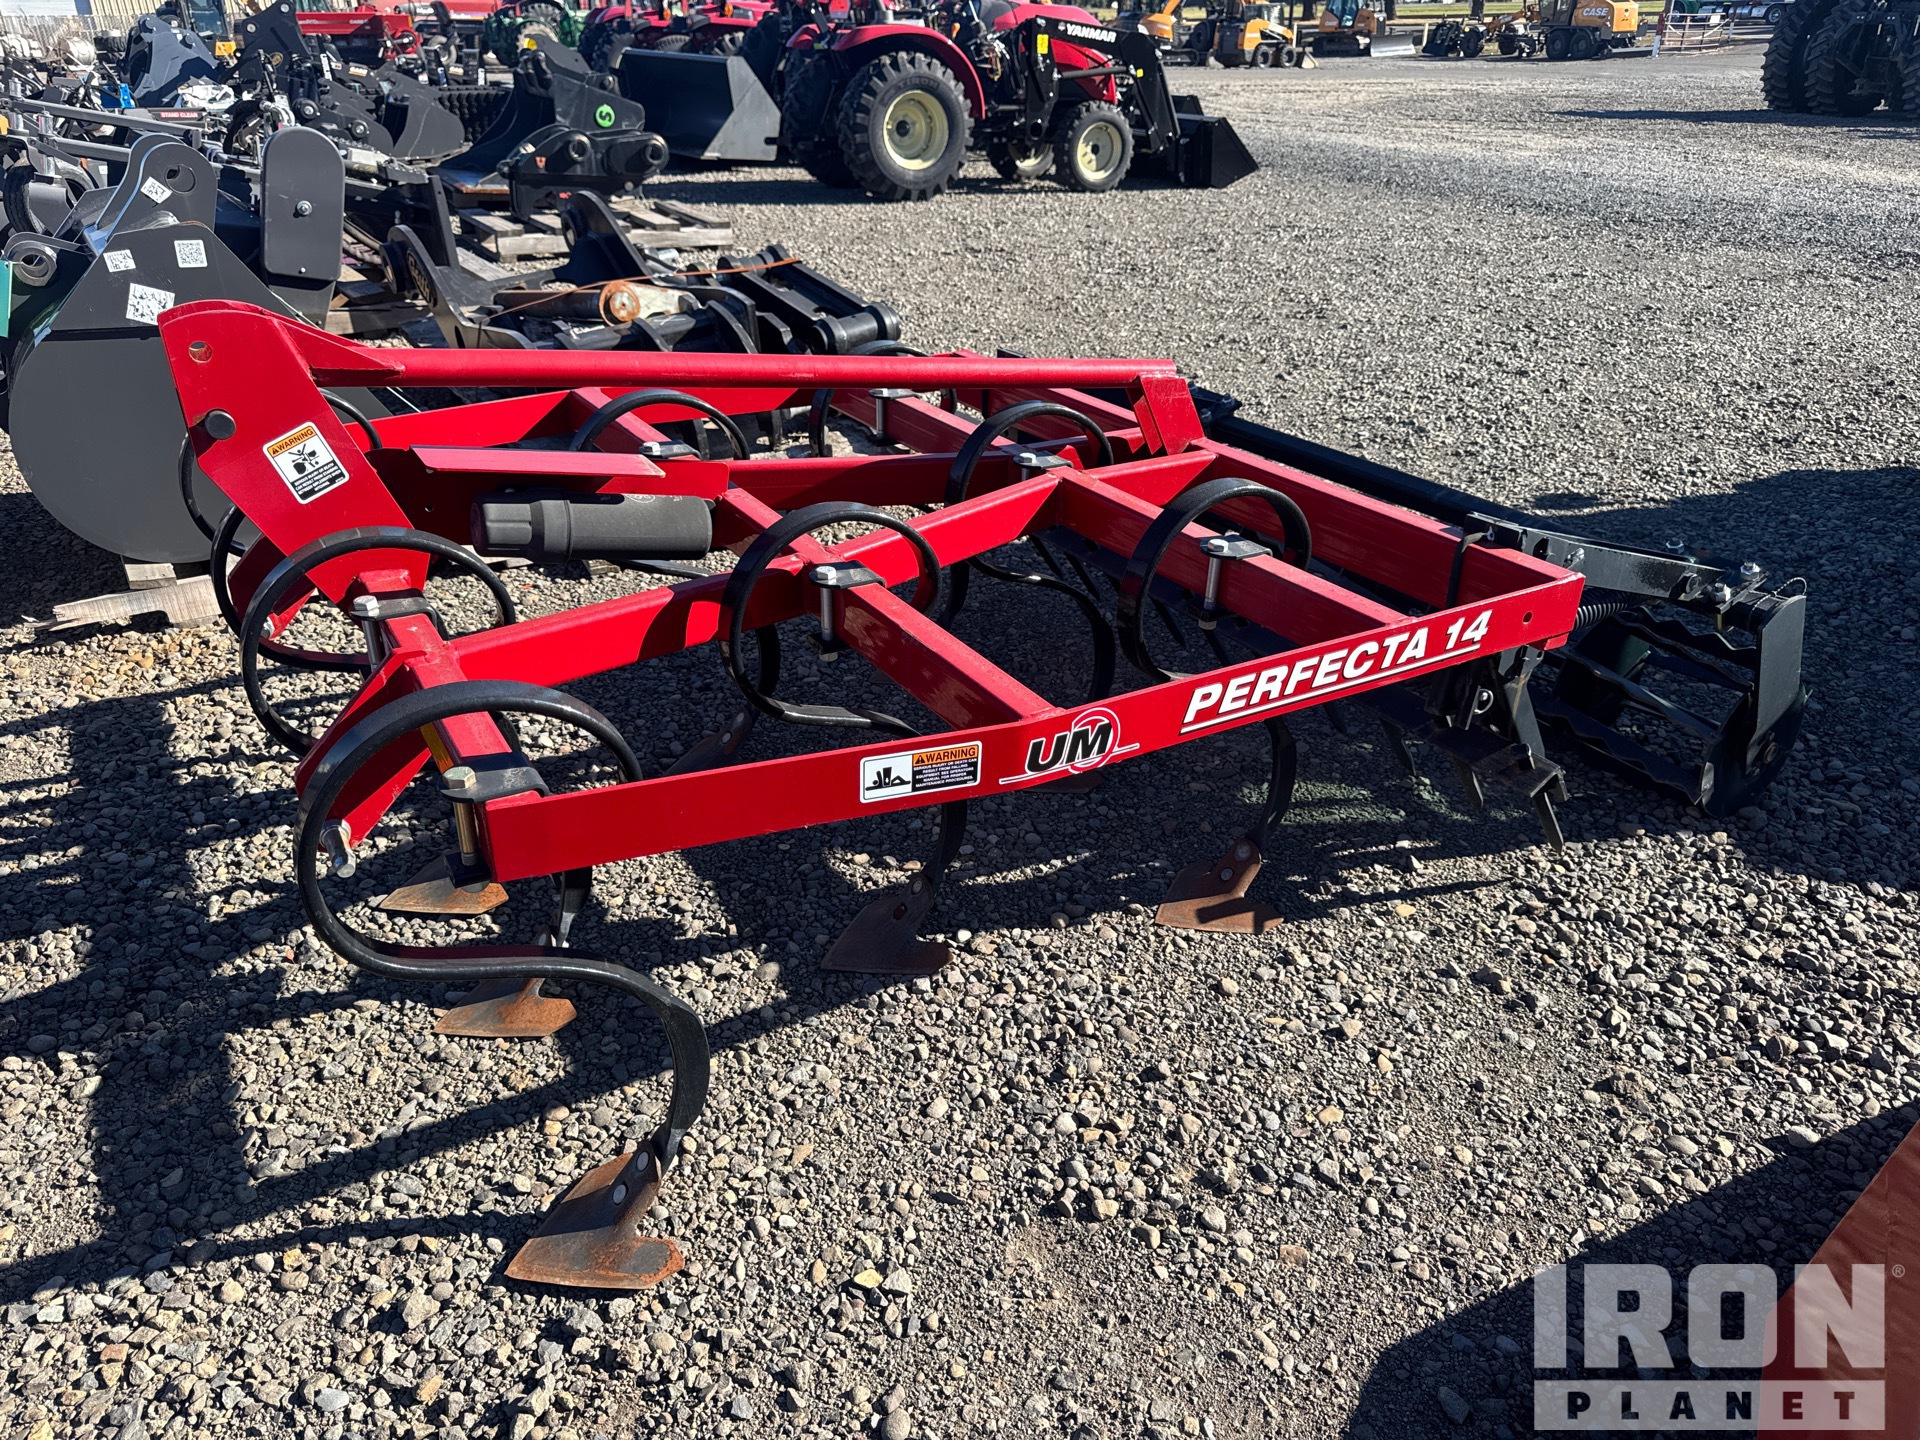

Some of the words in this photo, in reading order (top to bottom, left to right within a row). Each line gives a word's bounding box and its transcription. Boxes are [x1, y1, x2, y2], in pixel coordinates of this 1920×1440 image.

[1583, 7, 1609, 16] CASE
[1066, 23, 1117, 43] YANMAR
[278, 429, 314, 451] WARNING
[1182, 627, 1429, 724] PERFECTA
[1445, 610, 1493, 651] 14
[926, 747, 976, 763] WARNING
[1025, 722, 1113, 773] UM
